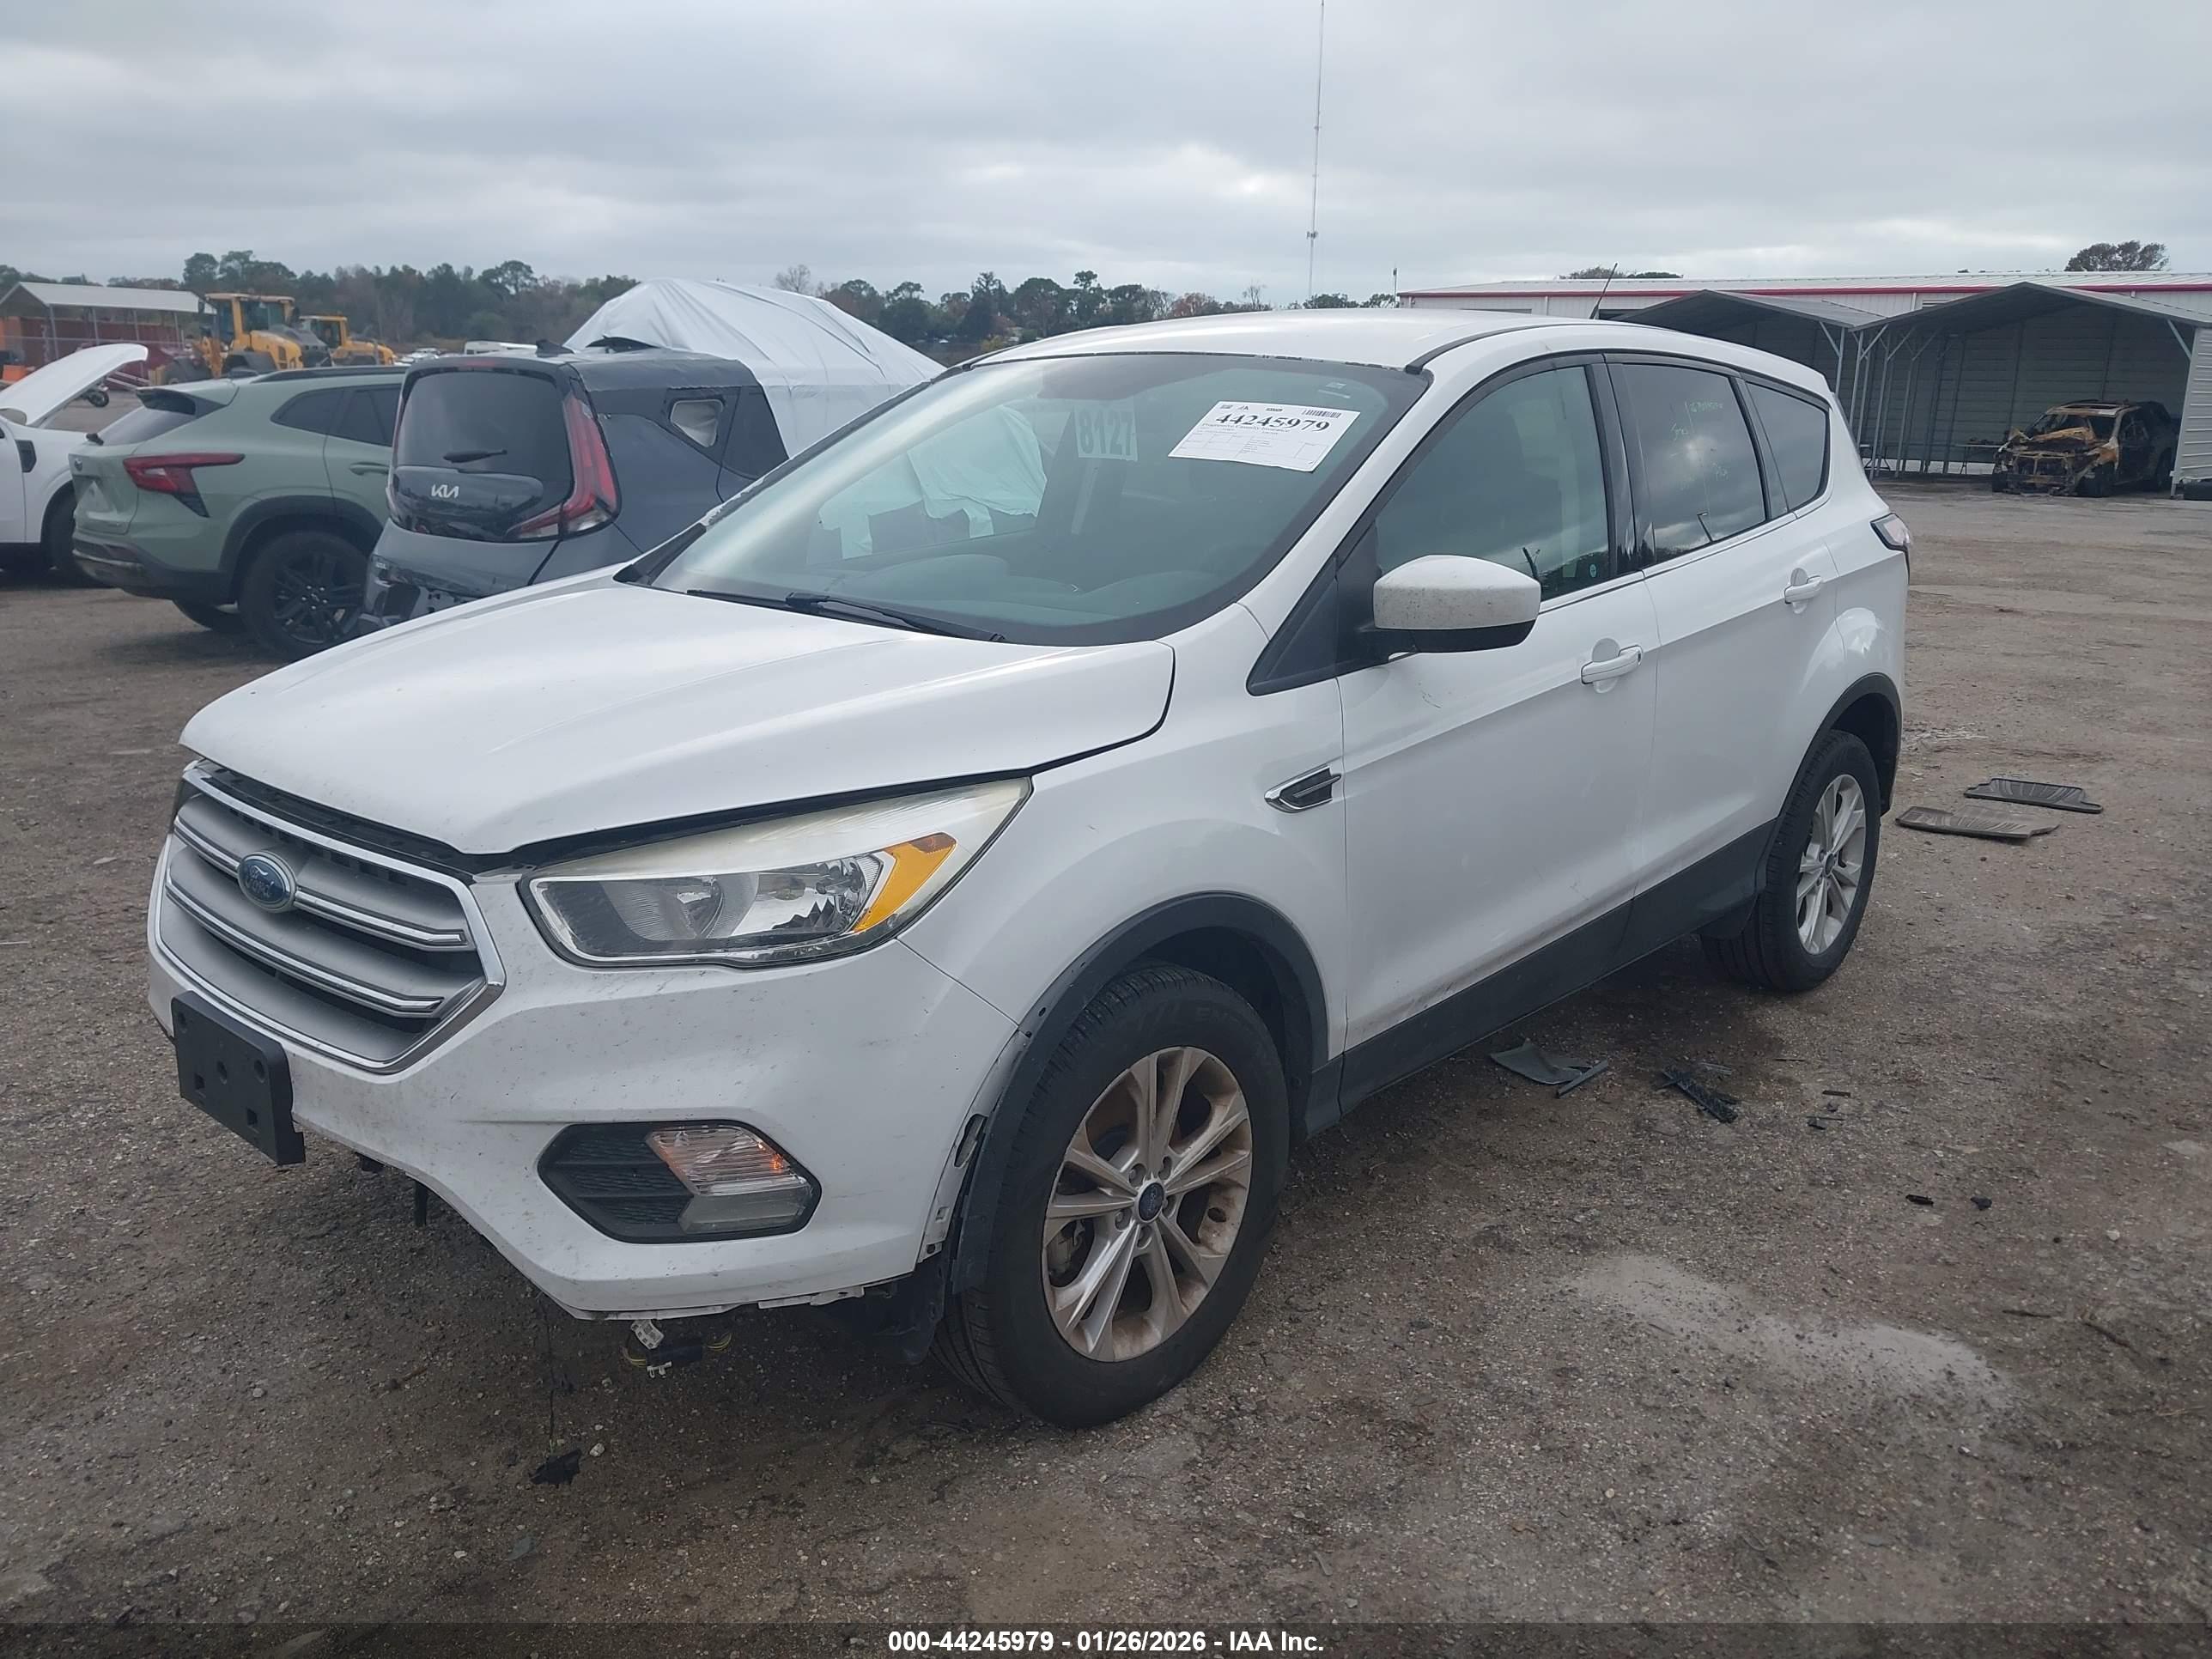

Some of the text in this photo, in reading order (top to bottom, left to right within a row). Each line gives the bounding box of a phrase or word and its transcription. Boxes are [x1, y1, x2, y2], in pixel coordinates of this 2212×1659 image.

[1215, 413, 1330, 432] 44245979
[1079, 409, 1133, 456] 8127
[431, 483, 459, 499] KIA
